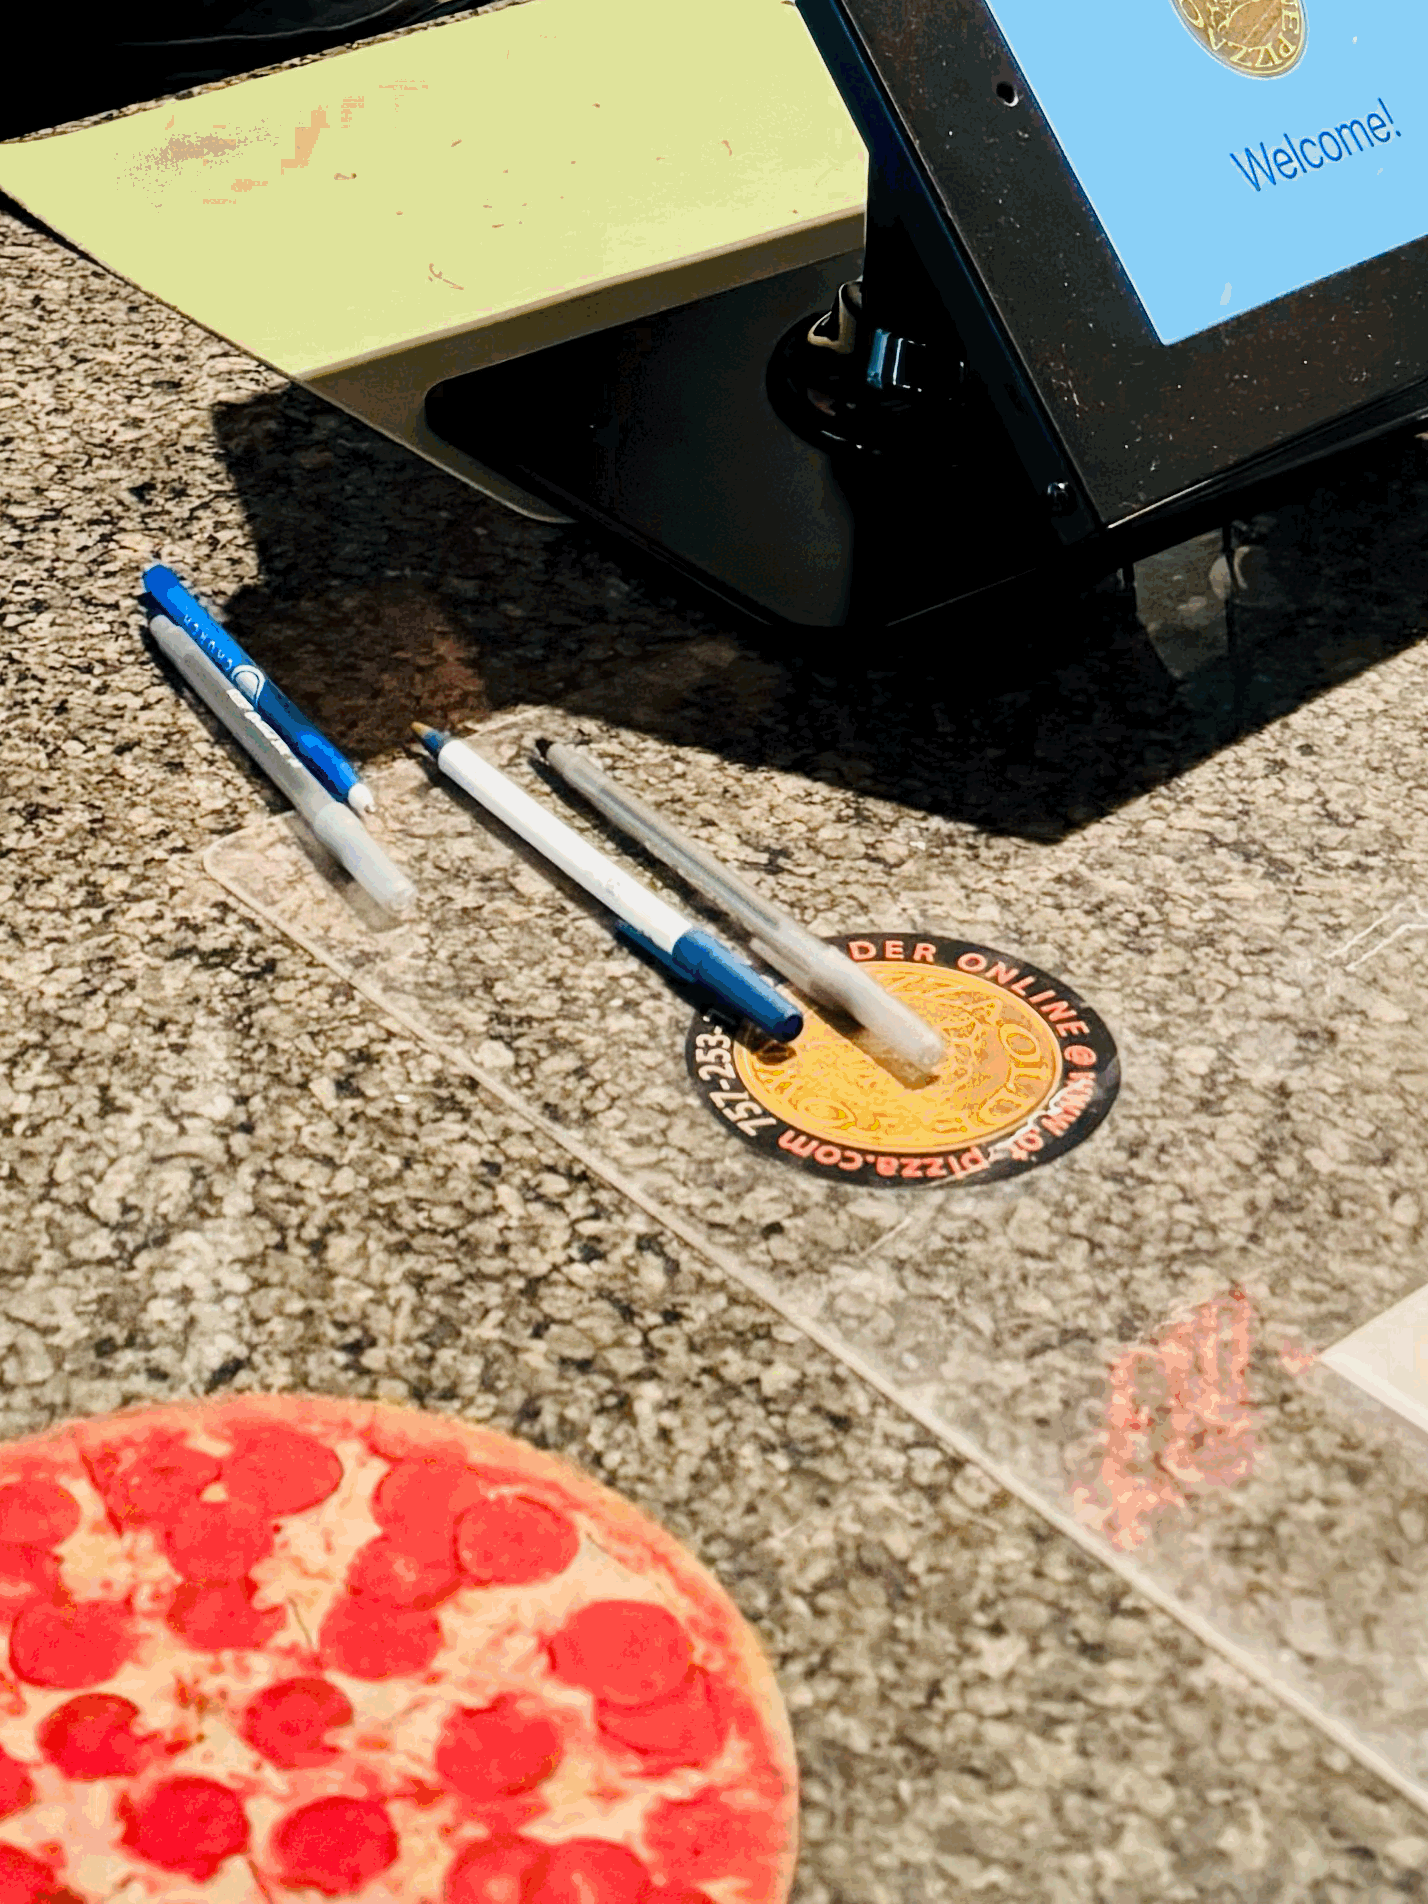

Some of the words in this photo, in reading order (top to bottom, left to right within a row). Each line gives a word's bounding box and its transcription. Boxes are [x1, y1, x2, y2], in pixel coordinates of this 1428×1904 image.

[1230, 97, 1403, 194] Welcome!
[847, 939, 937, 964] DER
[957, 952, 1089, 1038] ONLINE
